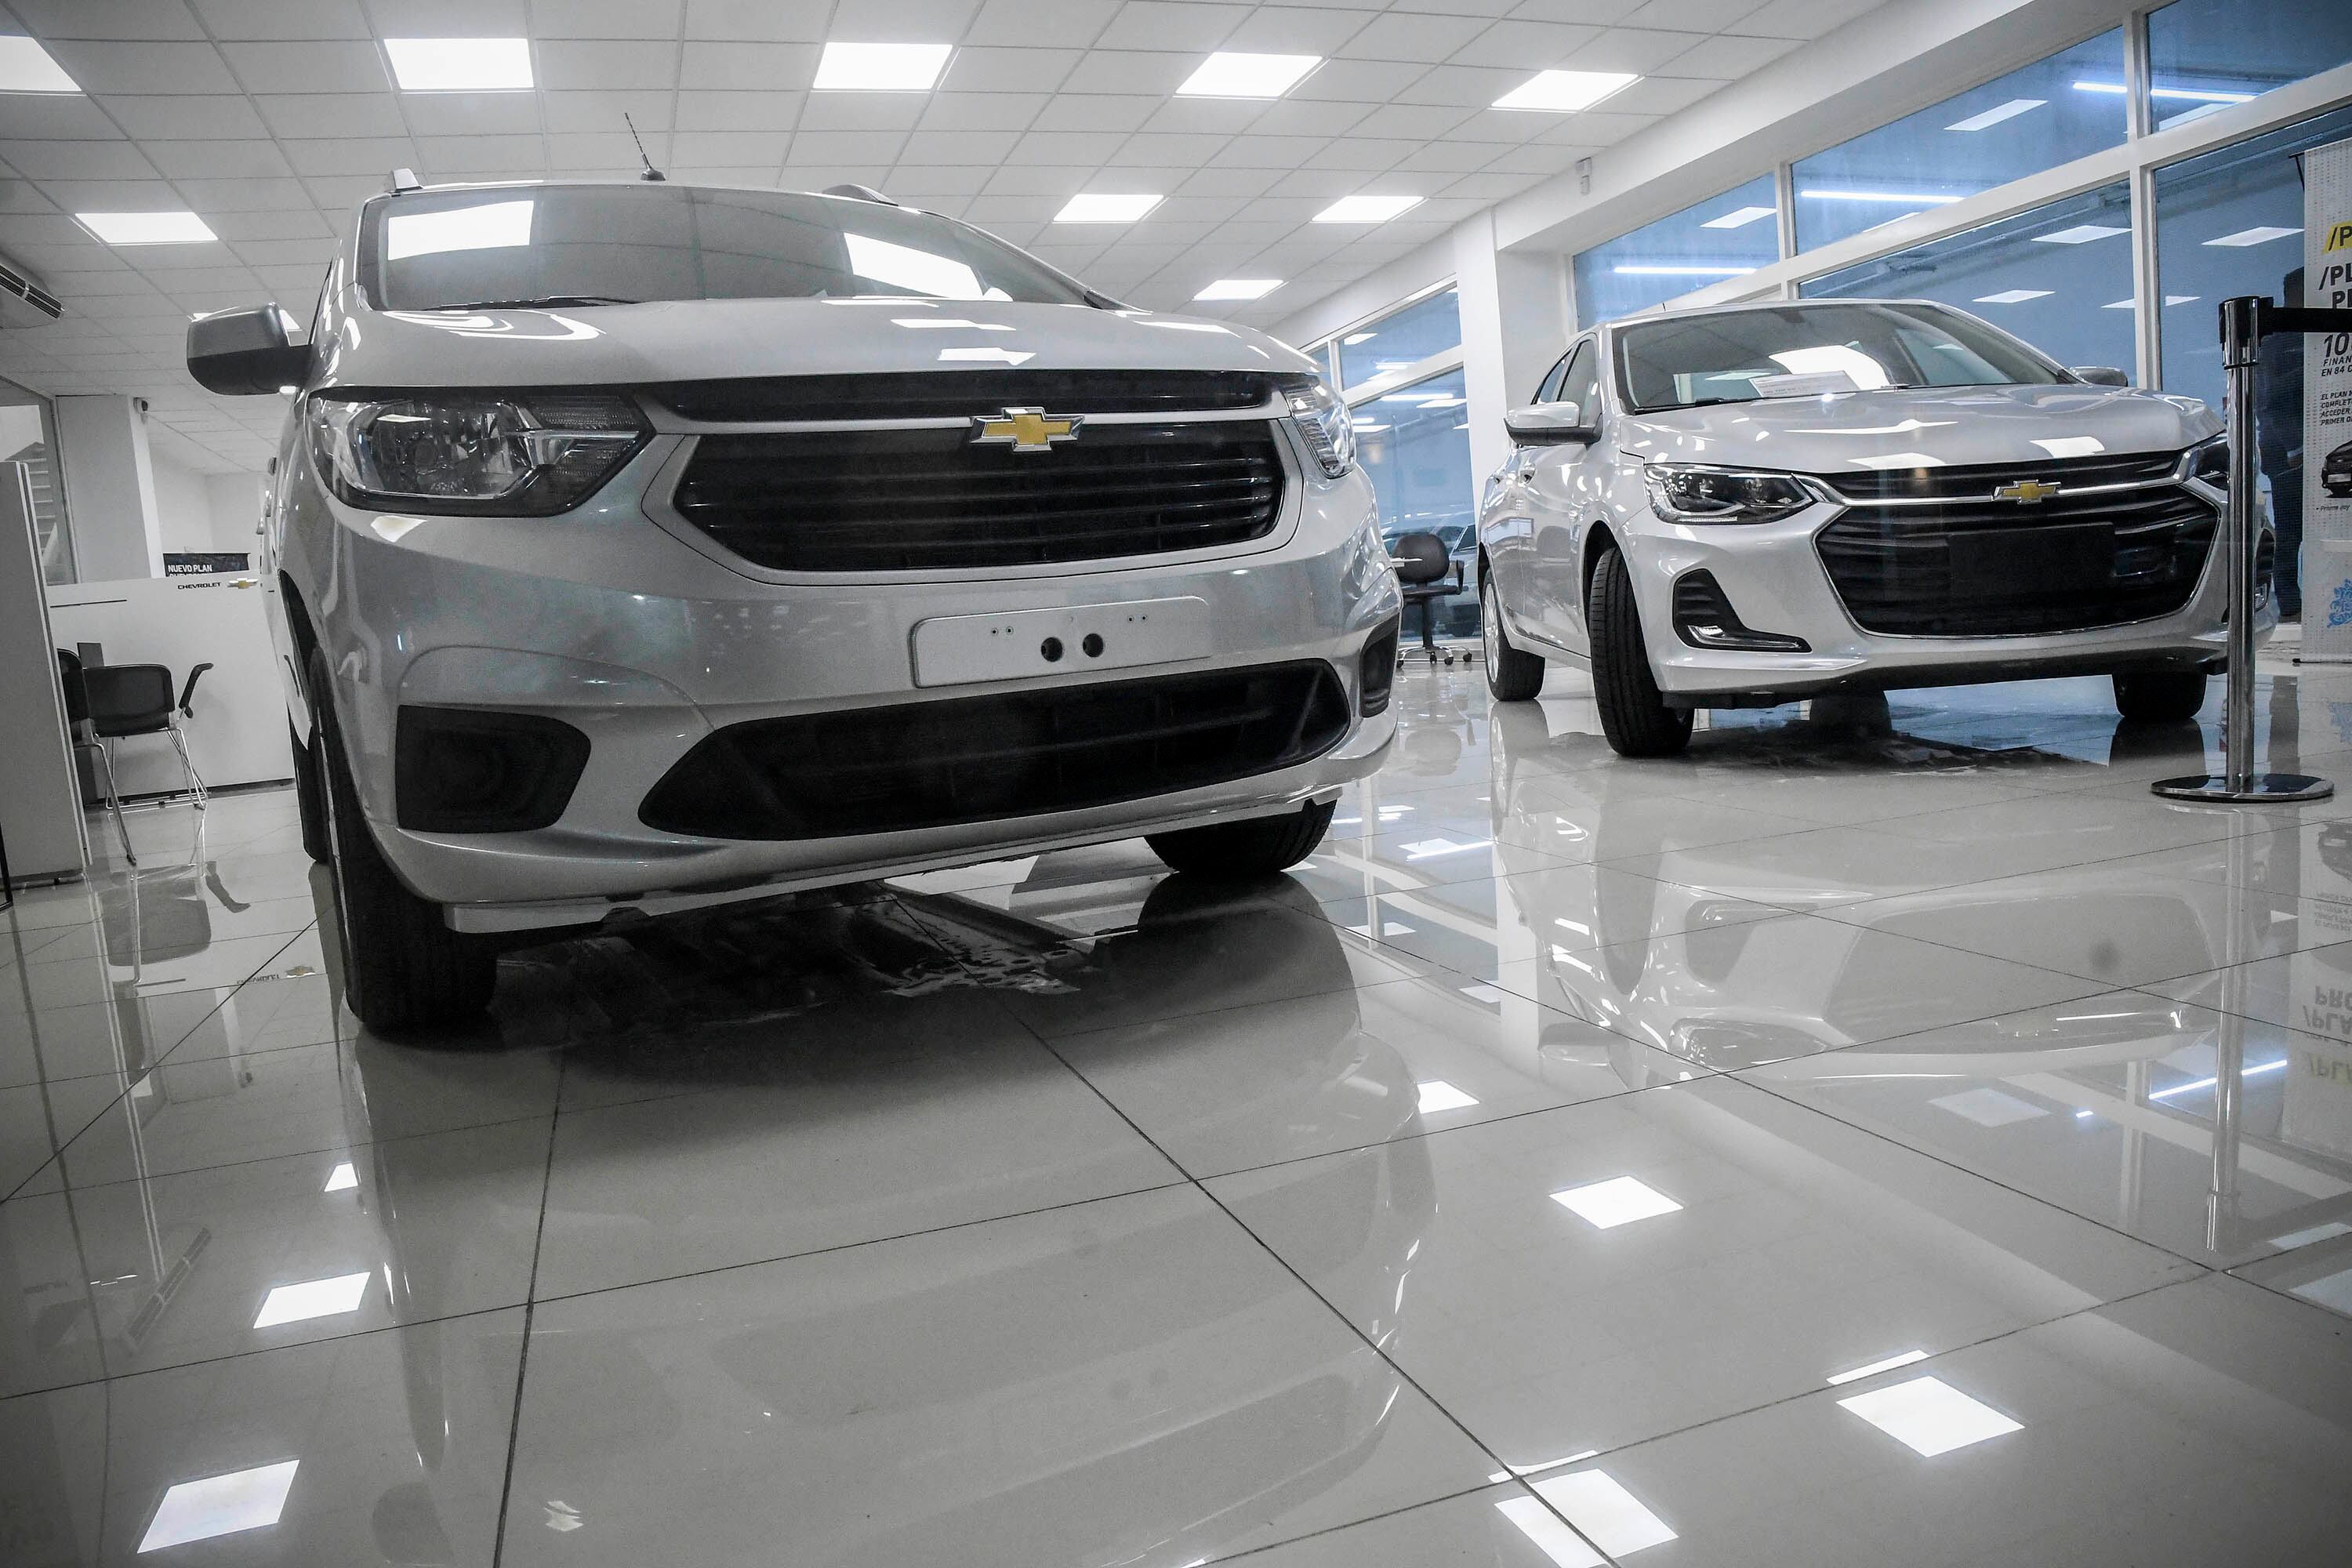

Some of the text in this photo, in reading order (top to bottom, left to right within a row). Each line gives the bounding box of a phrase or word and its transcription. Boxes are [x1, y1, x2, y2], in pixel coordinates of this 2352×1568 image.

[2324, 332, 2352, 358] 10
[2334, 366, 2344, 375] 84
[2321, 398, 2352, 408] COMPLET
[2320, 408, 2350, 418] ACCEDER
[2321, 417, 2344, 426] PRIMER
[167, 564, 212, 573] NUEVO PLAN
[177, 582, 221, 590] CHEVROLET
